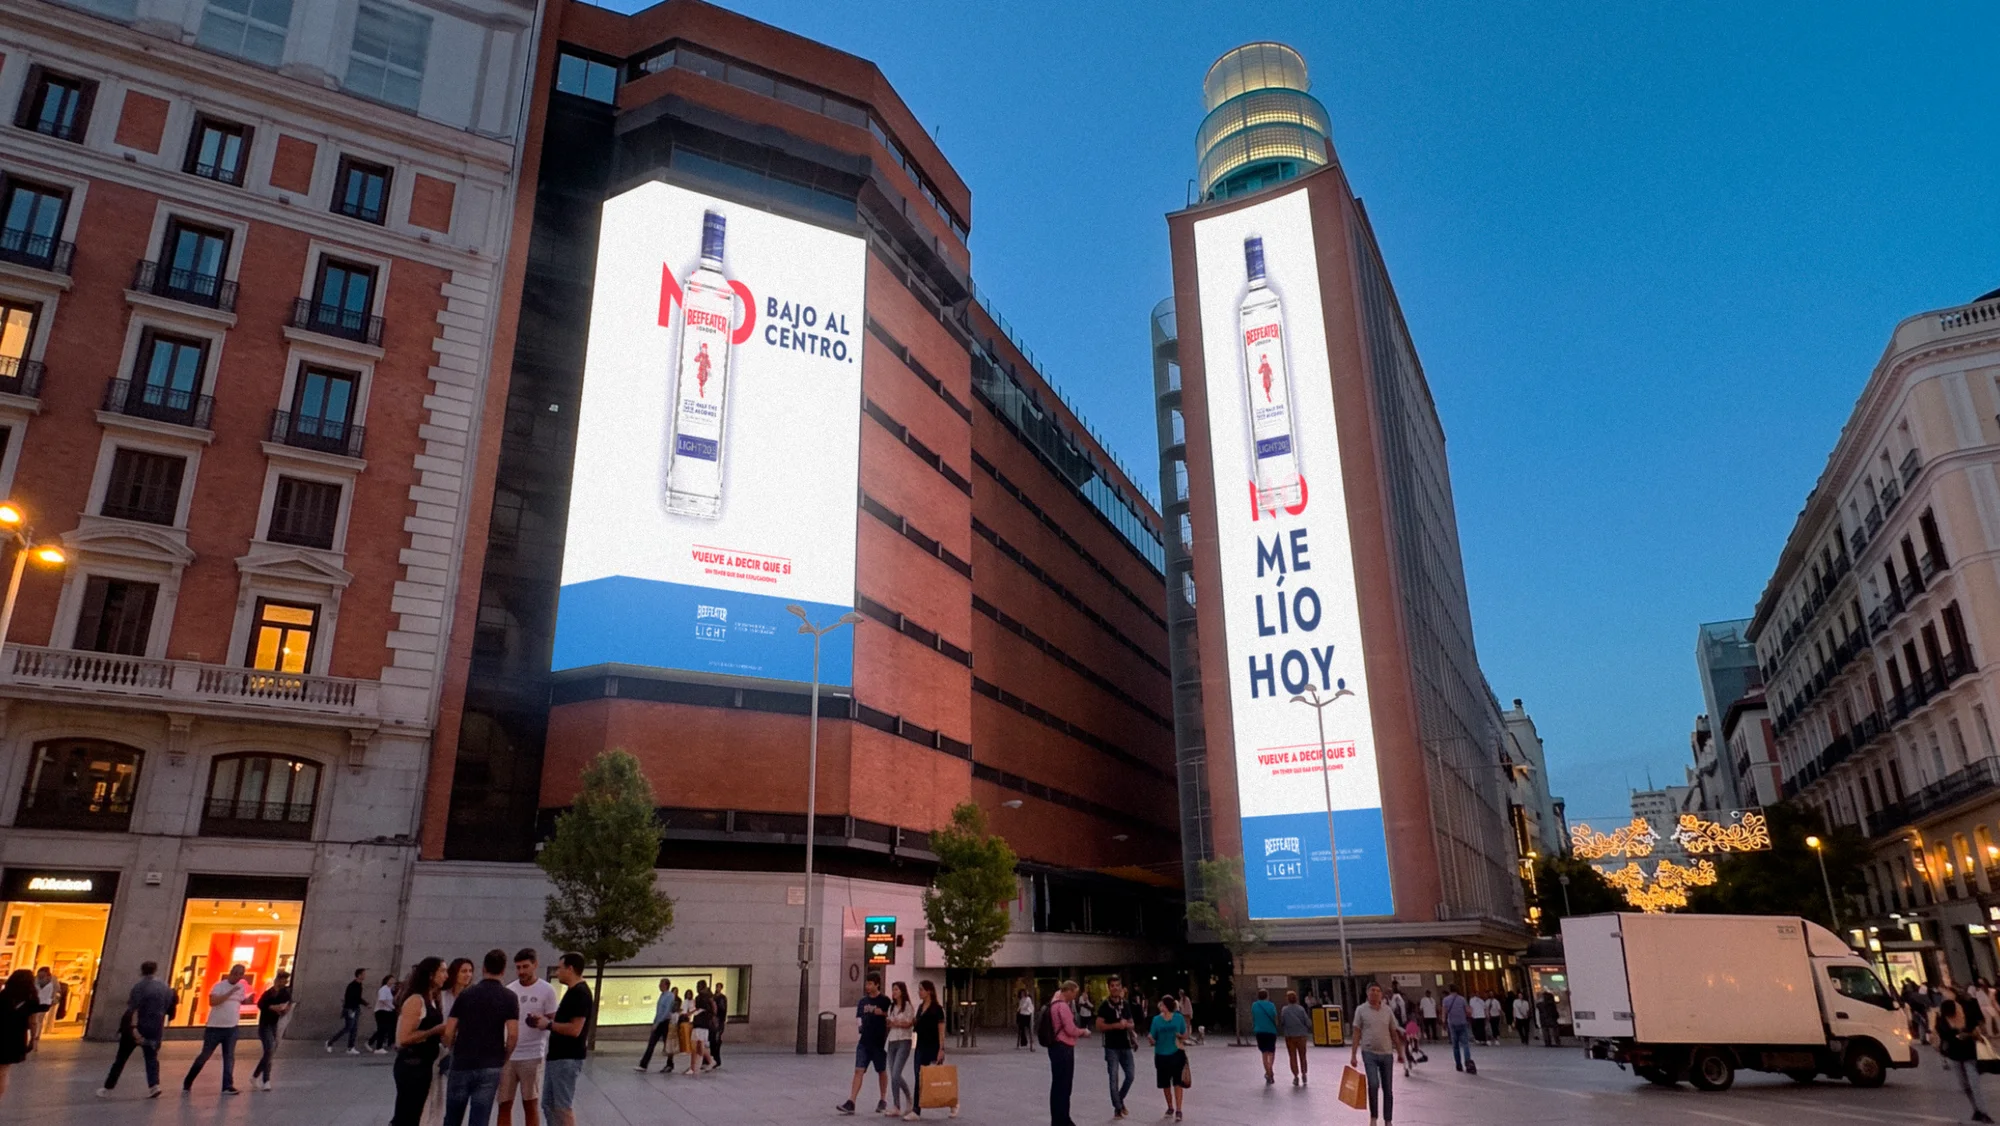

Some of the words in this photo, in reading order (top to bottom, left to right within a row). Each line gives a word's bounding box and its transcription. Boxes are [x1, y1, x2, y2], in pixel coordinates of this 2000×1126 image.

[686, 308, 727, 335] BEEFEATER
[766, 296, 817, 329] BAJO
[824, 311, 850, 335] AL
[764, 324, 853, 364] CENTRO.
[1245, 323, 1280, 346] BEEFEATER
[691, 550, 725, 565] VUELVE
[726, 556, 733, 567] A
[735, 556, 761, 570] DECIR
[762, 561, 781, 574] QUE
[1256, 527, 1312, 578] ME
[696, 604, 727, 623] BEEFEATER
[1255, 575, 1322, 638] LÍO
[695, 626, 726, 639] LIGHT
[1248, 644, 1346, 699] HOY.
[1257, 752, 1289, 766] VUELVE
[1291, 752, 1298, 763] A
[1326, 747, 1345, 760] QUE
[1264, 836, 1301, 857] BEEFEATER
[1266, 862, 1302, 877] LIGHT
